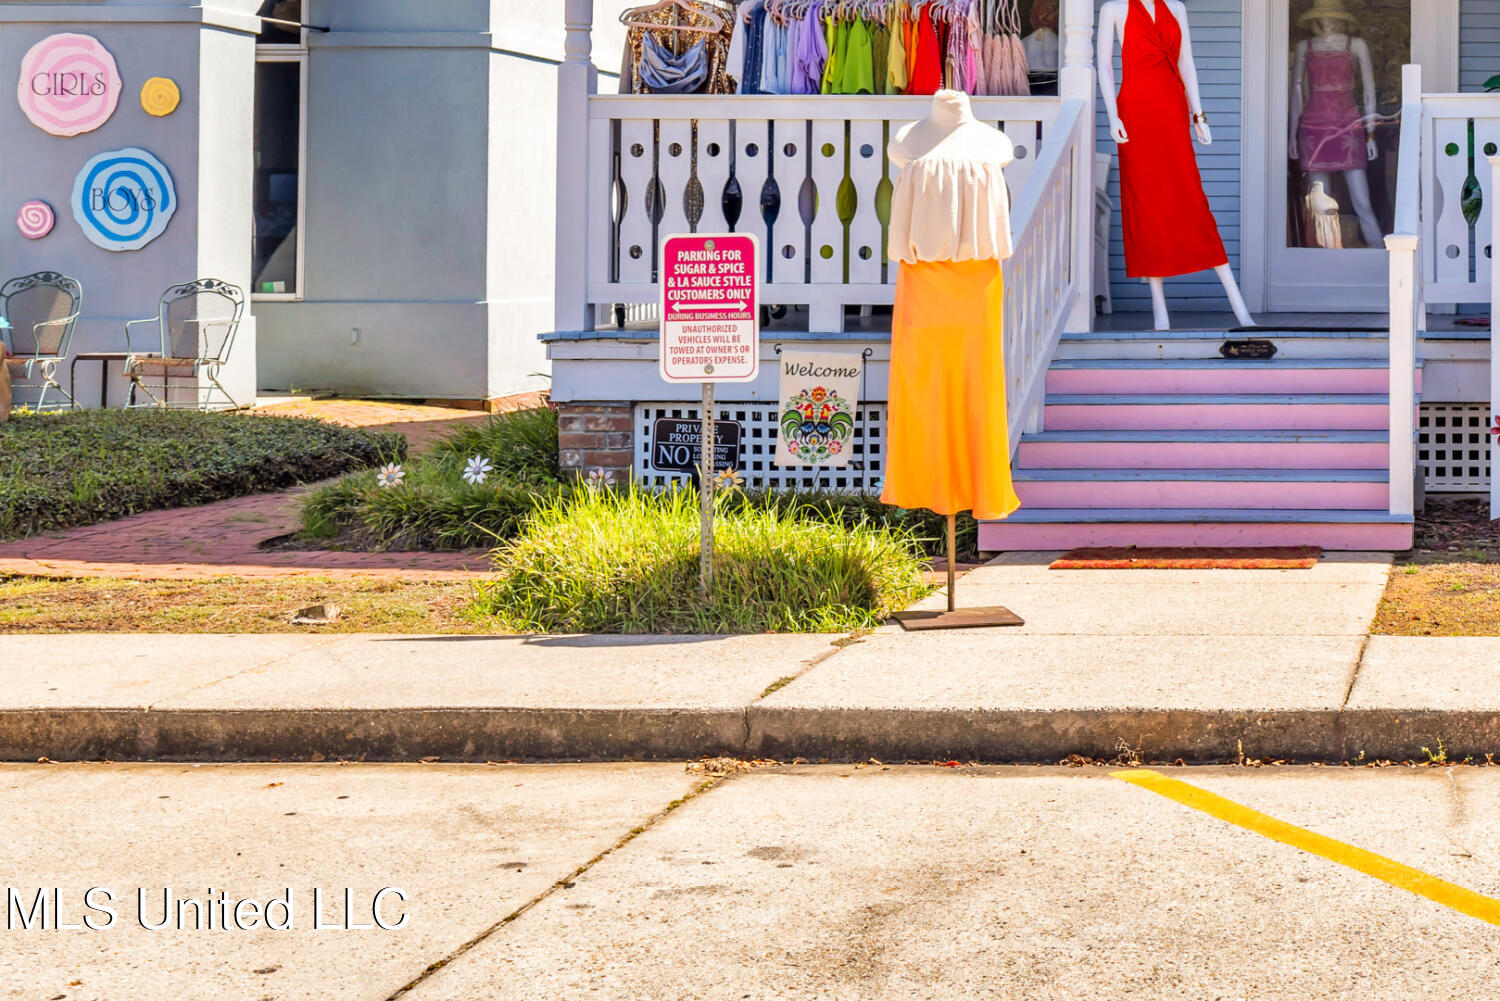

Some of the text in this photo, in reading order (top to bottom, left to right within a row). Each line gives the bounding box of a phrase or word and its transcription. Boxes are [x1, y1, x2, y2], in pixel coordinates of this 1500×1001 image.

[31, 72, 107, 96] GIRLS
[92, 187, 156, 212] BOYS
[678, 250, 742, 261] PARKING FOR
[674, 263, 745, 274] SUGAR & SPICE
[667, 275, 751, 287] & LA SAUCE STYLE
[667, 288, 751, 300] CUSTOMERS ONLY
[682, 325, 737, 333] UNAUTHORIZED
[678, 335, 741, 344] VEHICLES WILL BE
[669, 345, 750, 354] TOWED AT OWNER'S OR
[672, 356, 712, 365] OPERATORS
[785, 362, 861, 378] Welcome
[669, 433, 724, 444] PROPEY
[658, 445, 690, 465] NO
